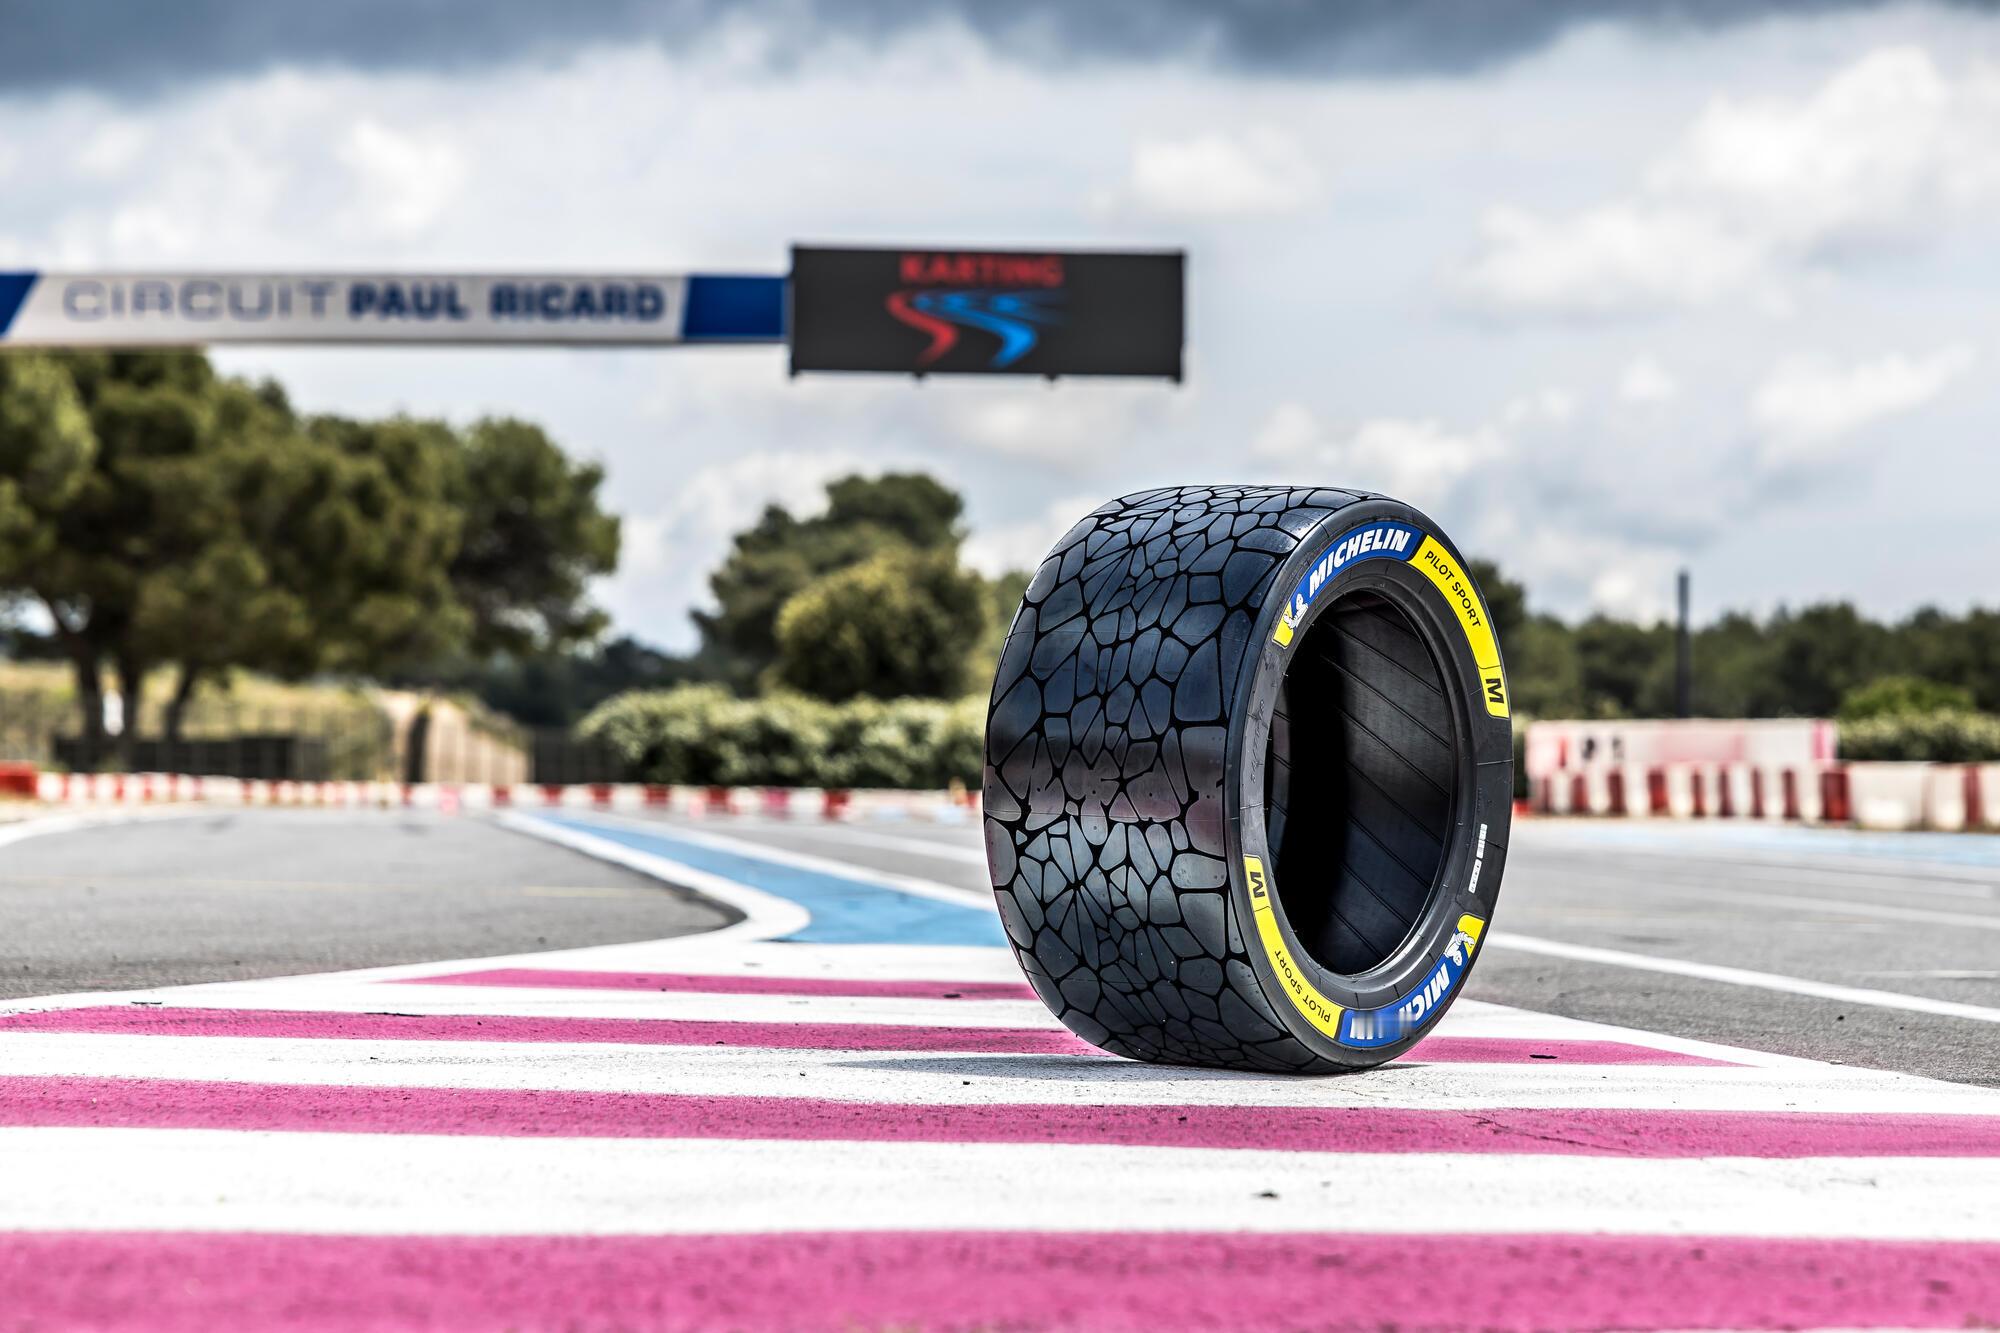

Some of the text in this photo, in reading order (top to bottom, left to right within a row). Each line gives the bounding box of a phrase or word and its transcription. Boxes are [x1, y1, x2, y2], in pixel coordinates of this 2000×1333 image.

[901, 253, 1063, 286] KARTING
[62, 280, 667, 323] CIRCUIT PAUL RICARD
[1309, 528, 1411, 598] MICHELIN
[1424, 550, 1481, 628] PILOT SPORT
[1485, 677, 1505, 704] M
[1249, 871, 1265, 898] M
[1274, 950, 1331, 1023] PILOT SPORT
